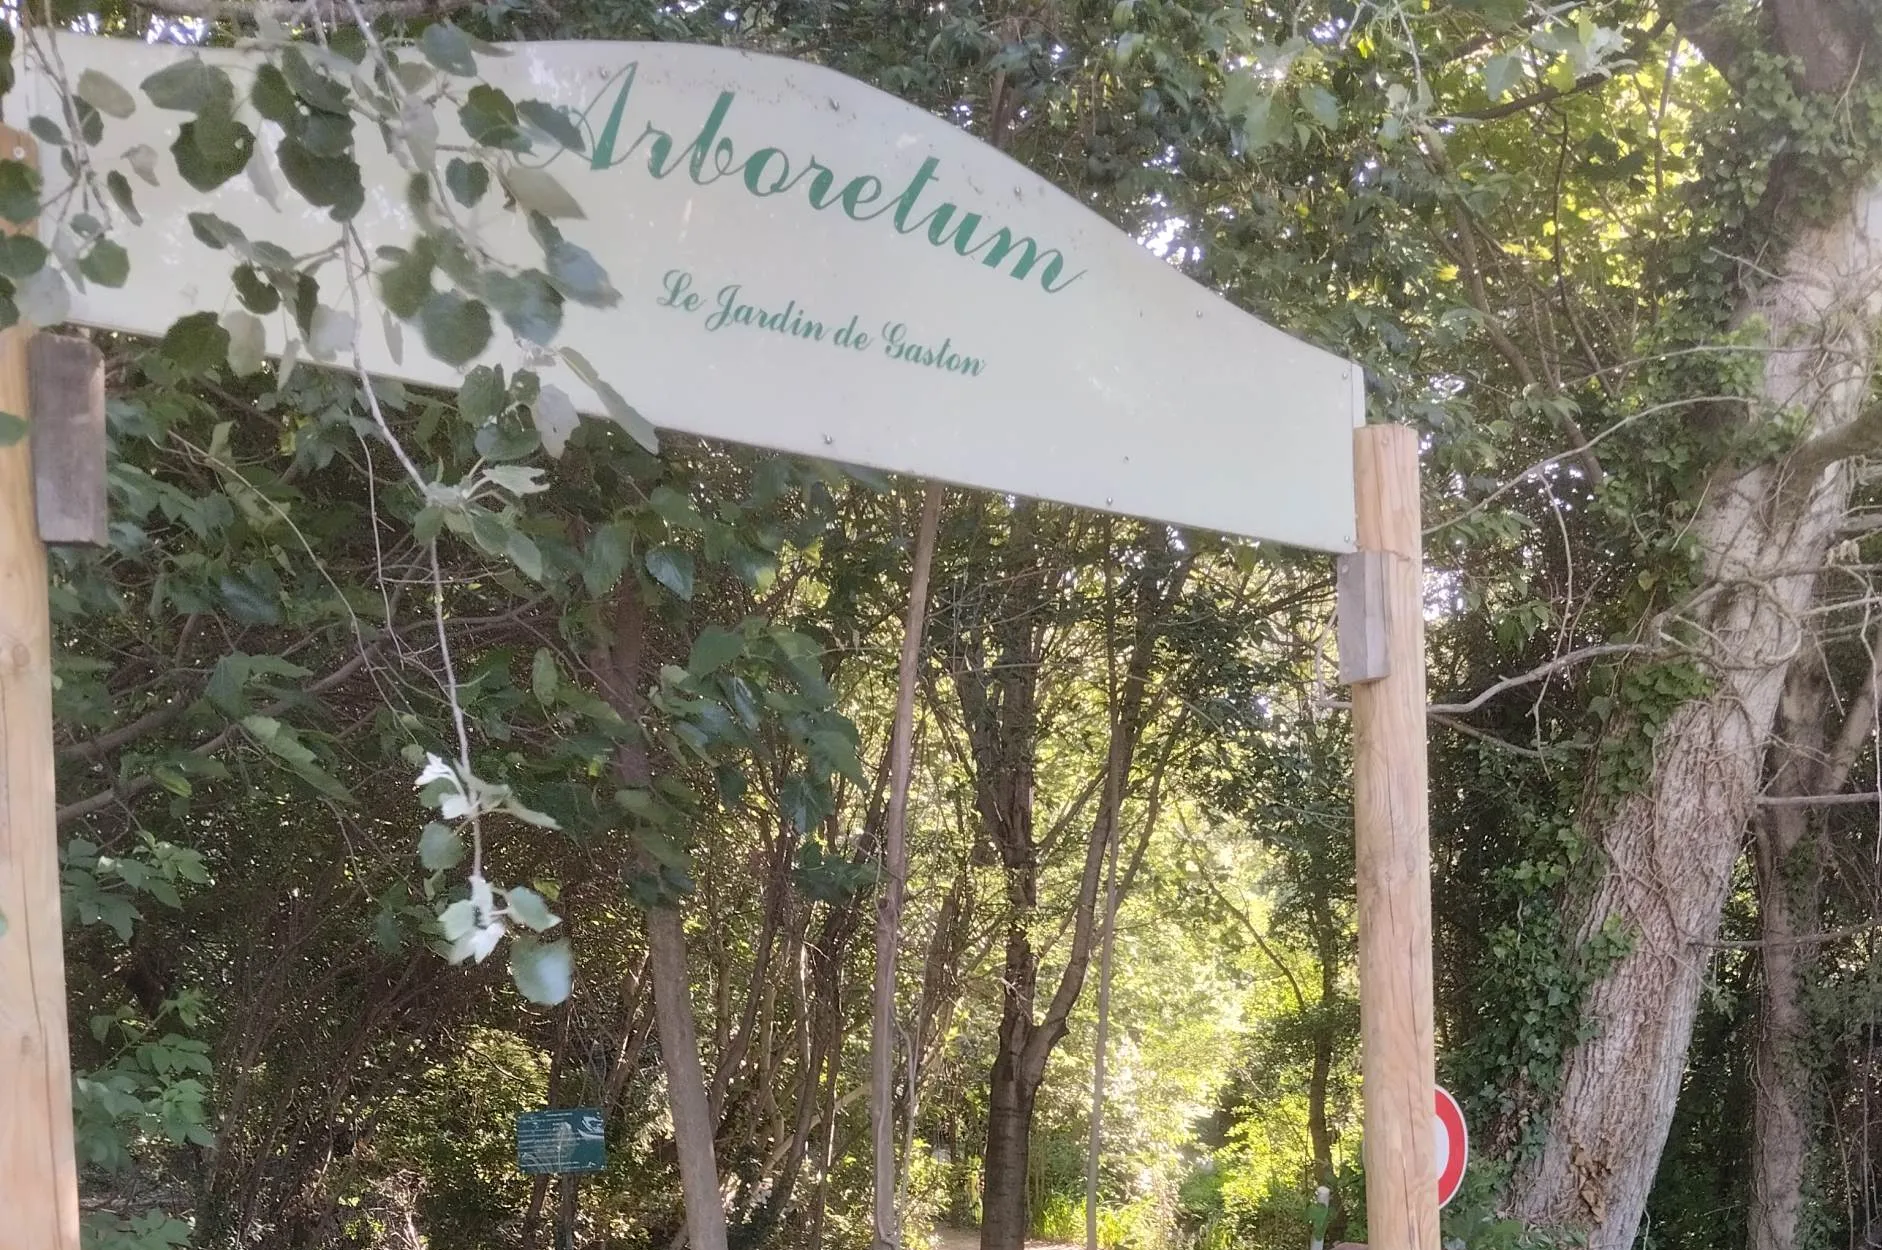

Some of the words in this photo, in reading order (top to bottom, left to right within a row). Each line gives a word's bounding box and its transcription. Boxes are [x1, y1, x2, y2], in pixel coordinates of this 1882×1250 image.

[512, 60, 1088, 293] Arboretum
[656, 269, 706, 312] Le
[704, 284, 829, 341] Jardin
[832, 314, 874, 351] de
[881, 320, 987, 377] Gaston
